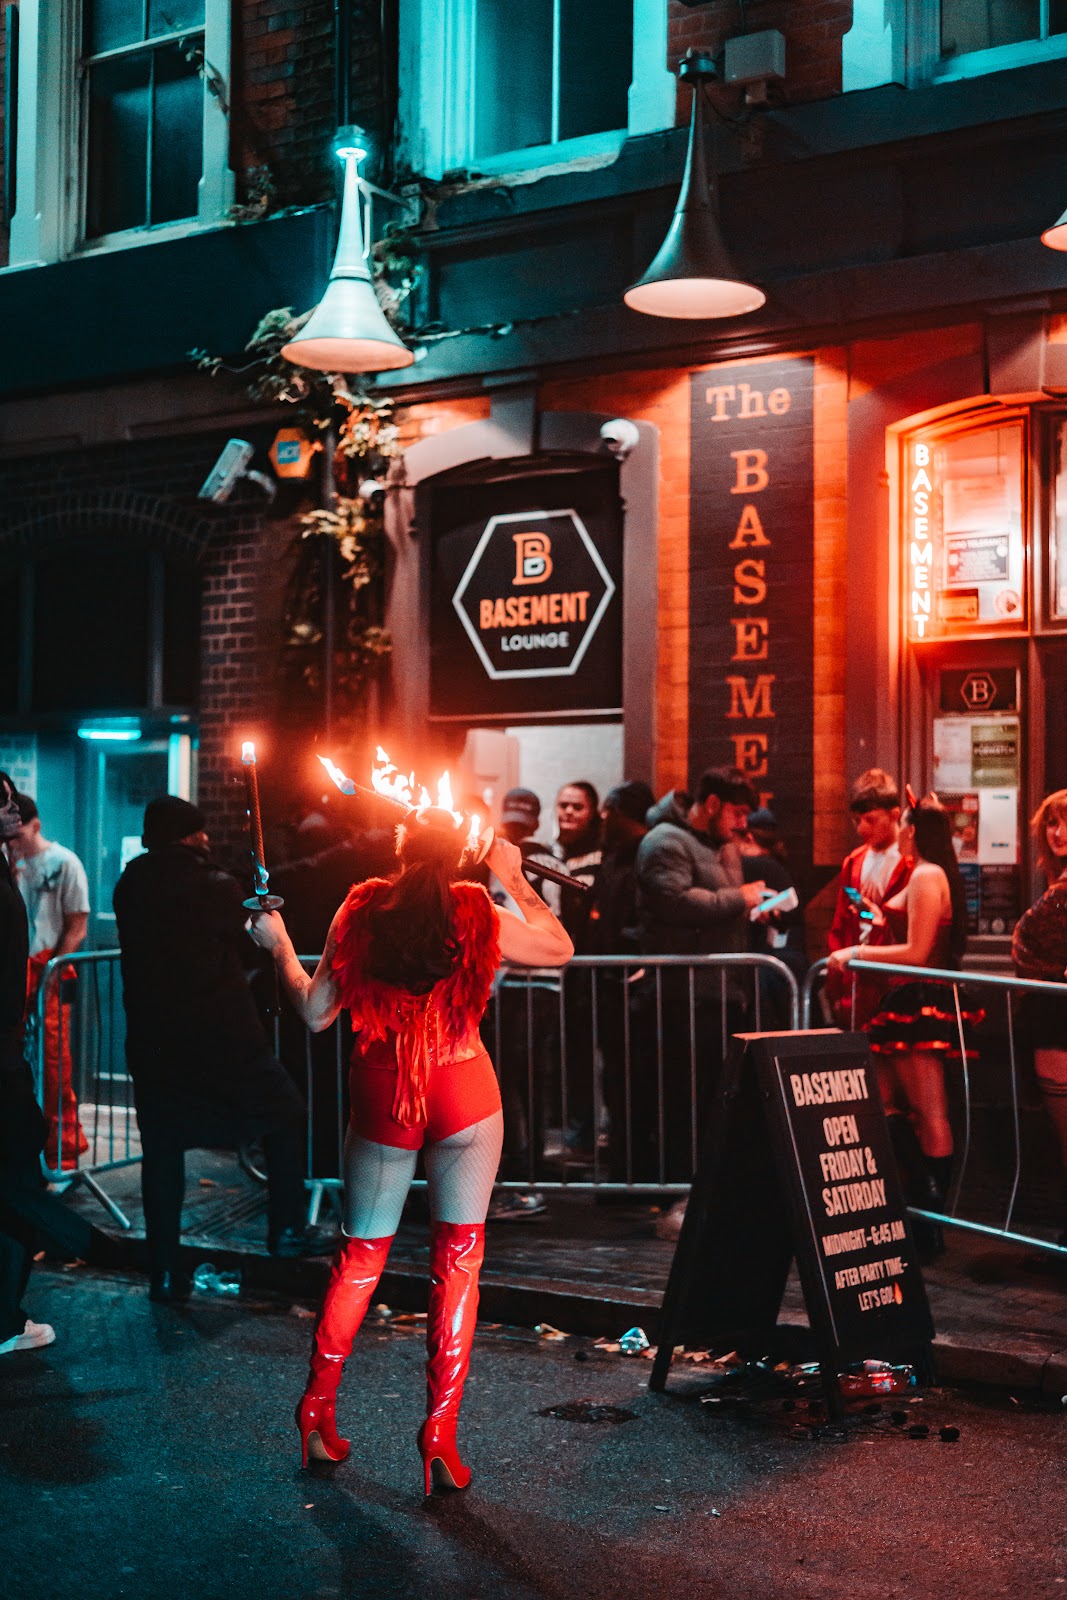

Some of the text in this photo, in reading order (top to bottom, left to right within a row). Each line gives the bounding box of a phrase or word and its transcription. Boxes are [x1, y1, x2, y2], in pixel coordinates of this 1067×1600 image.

[706, 384, 792, 422] The
[910, 443, 933, 638] BASEMENT
[480, 591, 591, 630] BASEMENT
[725, 449, 777, 809] BASEME
[501, 631, 570, 652] LOUNGE
[970, 679, 989, 702] B
[790, 1068, 869, 1107] BASEMENT
[822, 1114, 860, 1147] OPEN
[819, 1146, 878, 1183] FRIDAY &
[821, 1178, 887, 1217] SATURDAY
[834, 1267, 861, 1290] AFTER
[859, 1261, 885, 1283] PARTY
